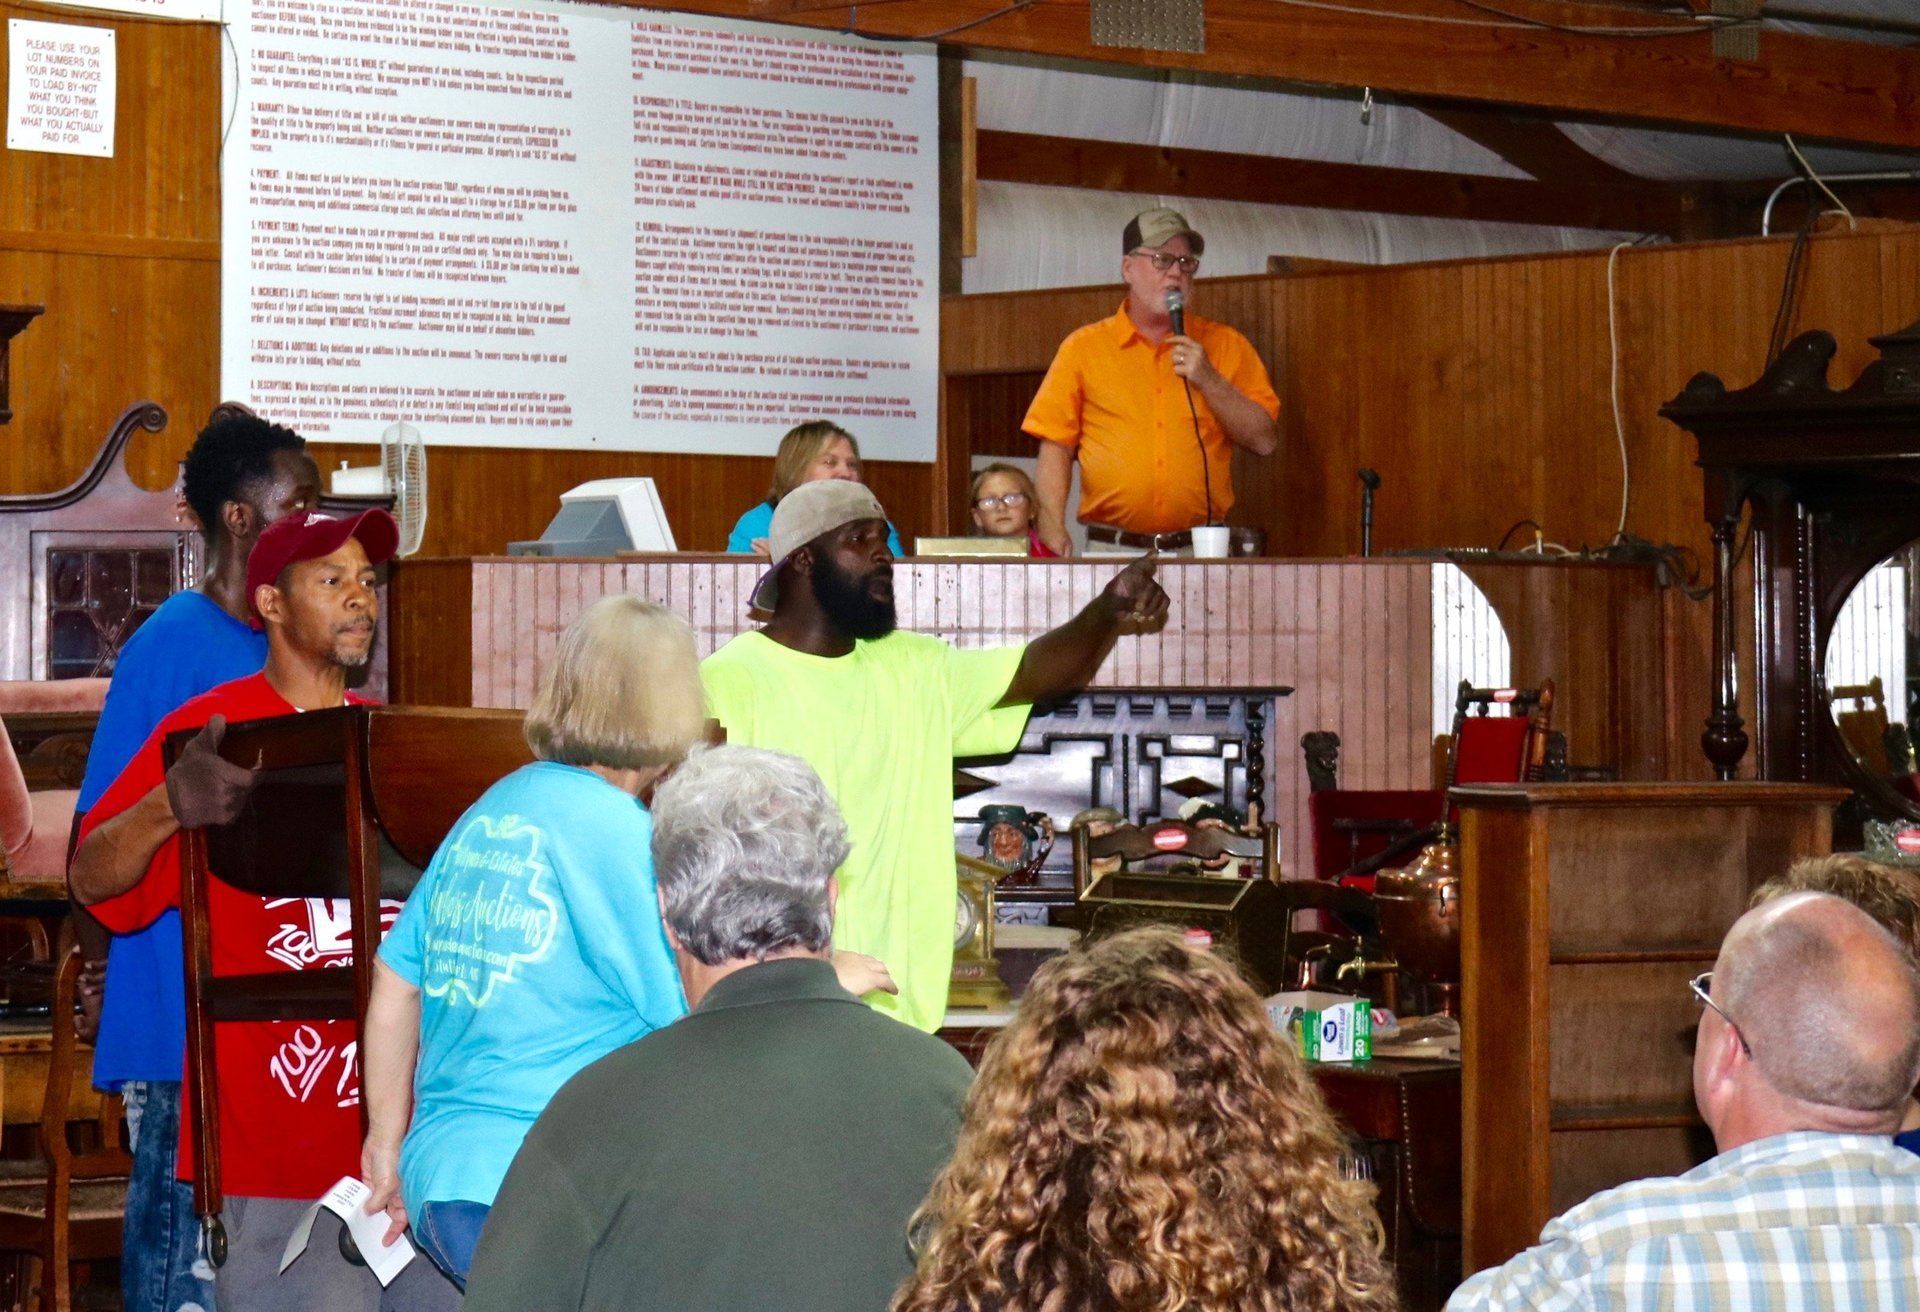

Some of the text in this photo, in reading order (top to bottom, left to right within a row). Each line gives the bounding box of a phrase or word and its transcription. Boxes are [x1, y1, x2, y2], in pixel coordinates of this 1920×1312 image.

[26, 39, 100, 55] PLEASE USE YOUR
[27, 53, 100, 68] LOT NUMBERS ON
[25, 65, 102, 81] YOUR PAID INVOICE
[29, 78, 40, 88] TO
[42, 80, 65, 90] LOAD
[29, 91, 97, 106] WHAT YOU THINK
[26, 104, 43, 114] YOU
[20, 116, 104, 133] WHAT YOU ACTUALLY
[41, 131, 60, 141] PAID
[1337, 1008, 1345, 1025] Leaf
[1355, 1040, 1365, 1056] 20
[269, 1024, 322, 1098] 100
